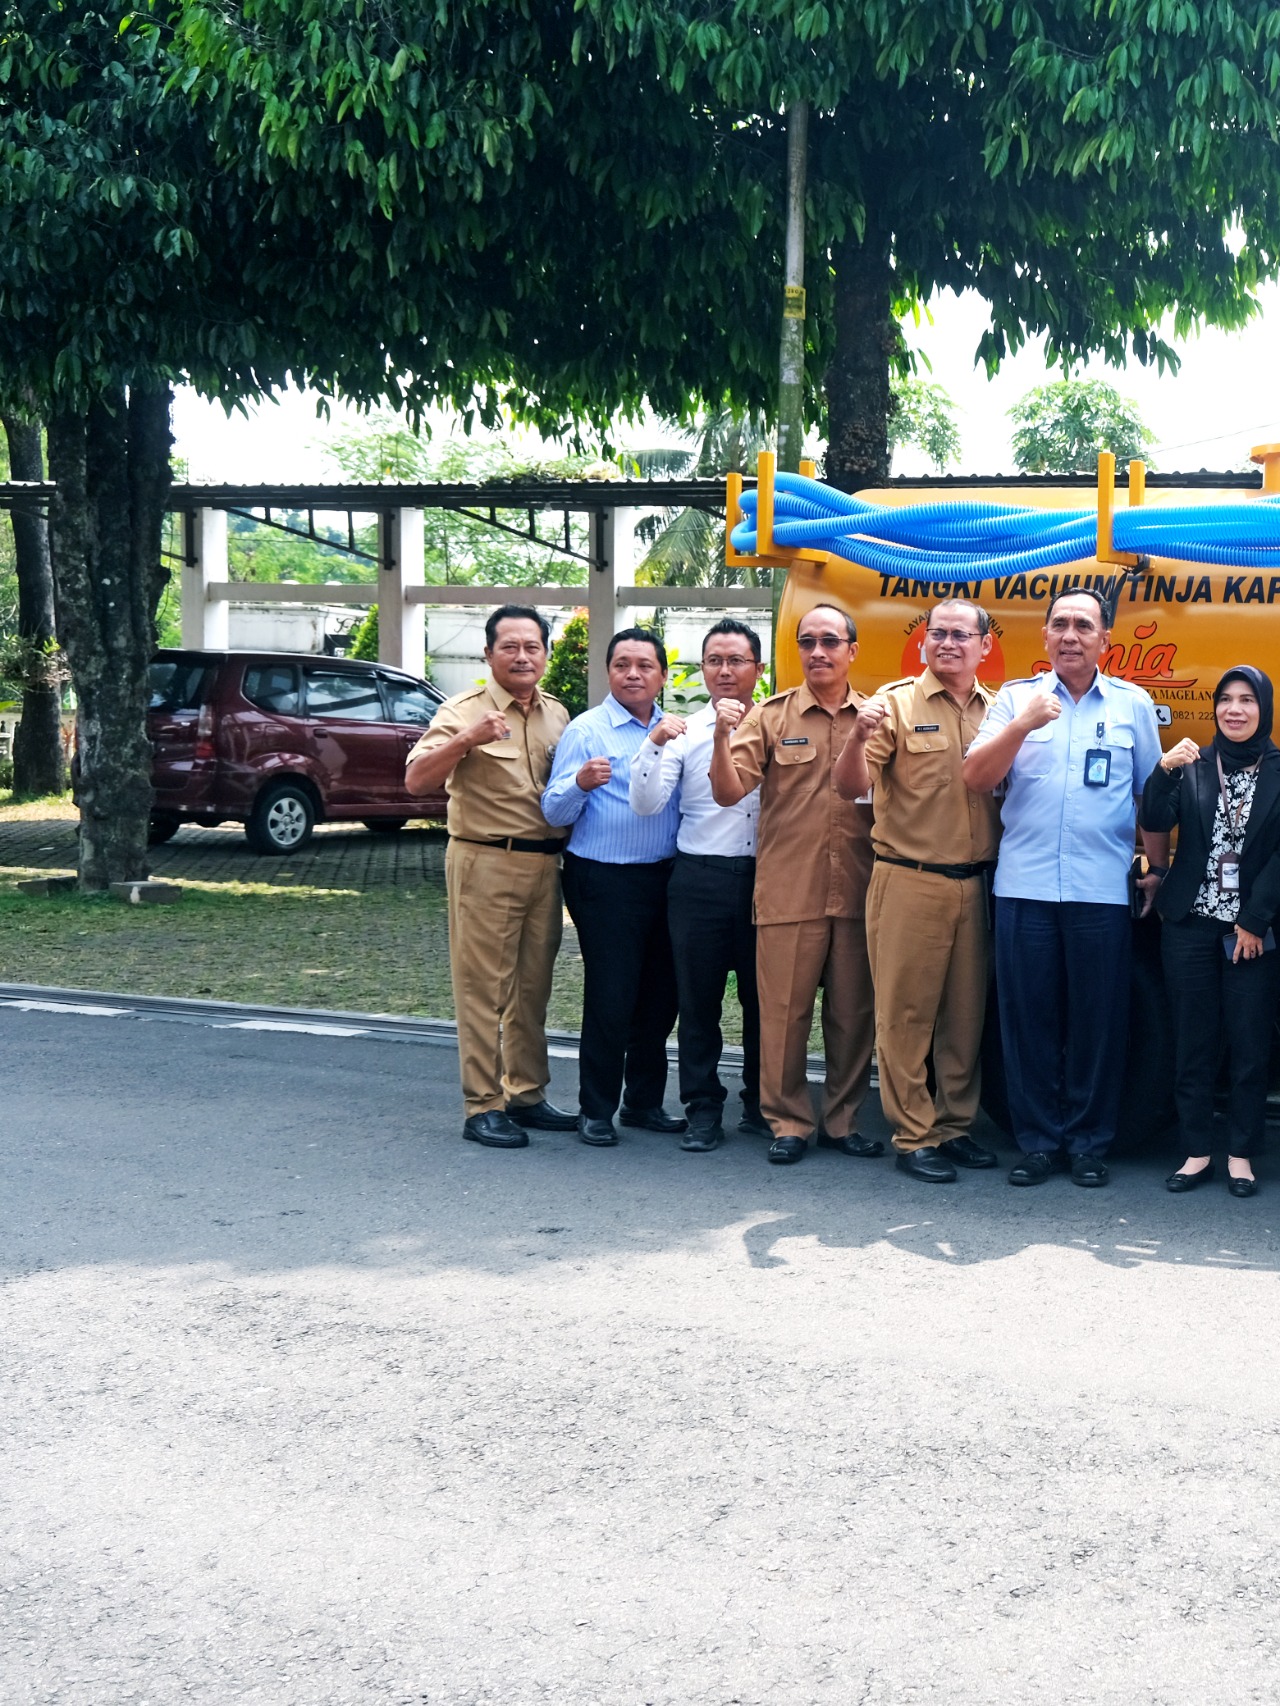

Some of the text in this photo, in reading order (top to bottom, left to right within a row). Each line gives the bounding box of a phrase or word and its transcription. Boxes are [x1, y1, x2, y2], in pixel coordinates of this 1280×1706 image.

[879, 572, 983, 598] TANGKI
[1125, 575, 1212, 602] TINJA
[1160, 690, 1215, 701] MAGELAN
[1172, 711, 1195, 720] 0821
